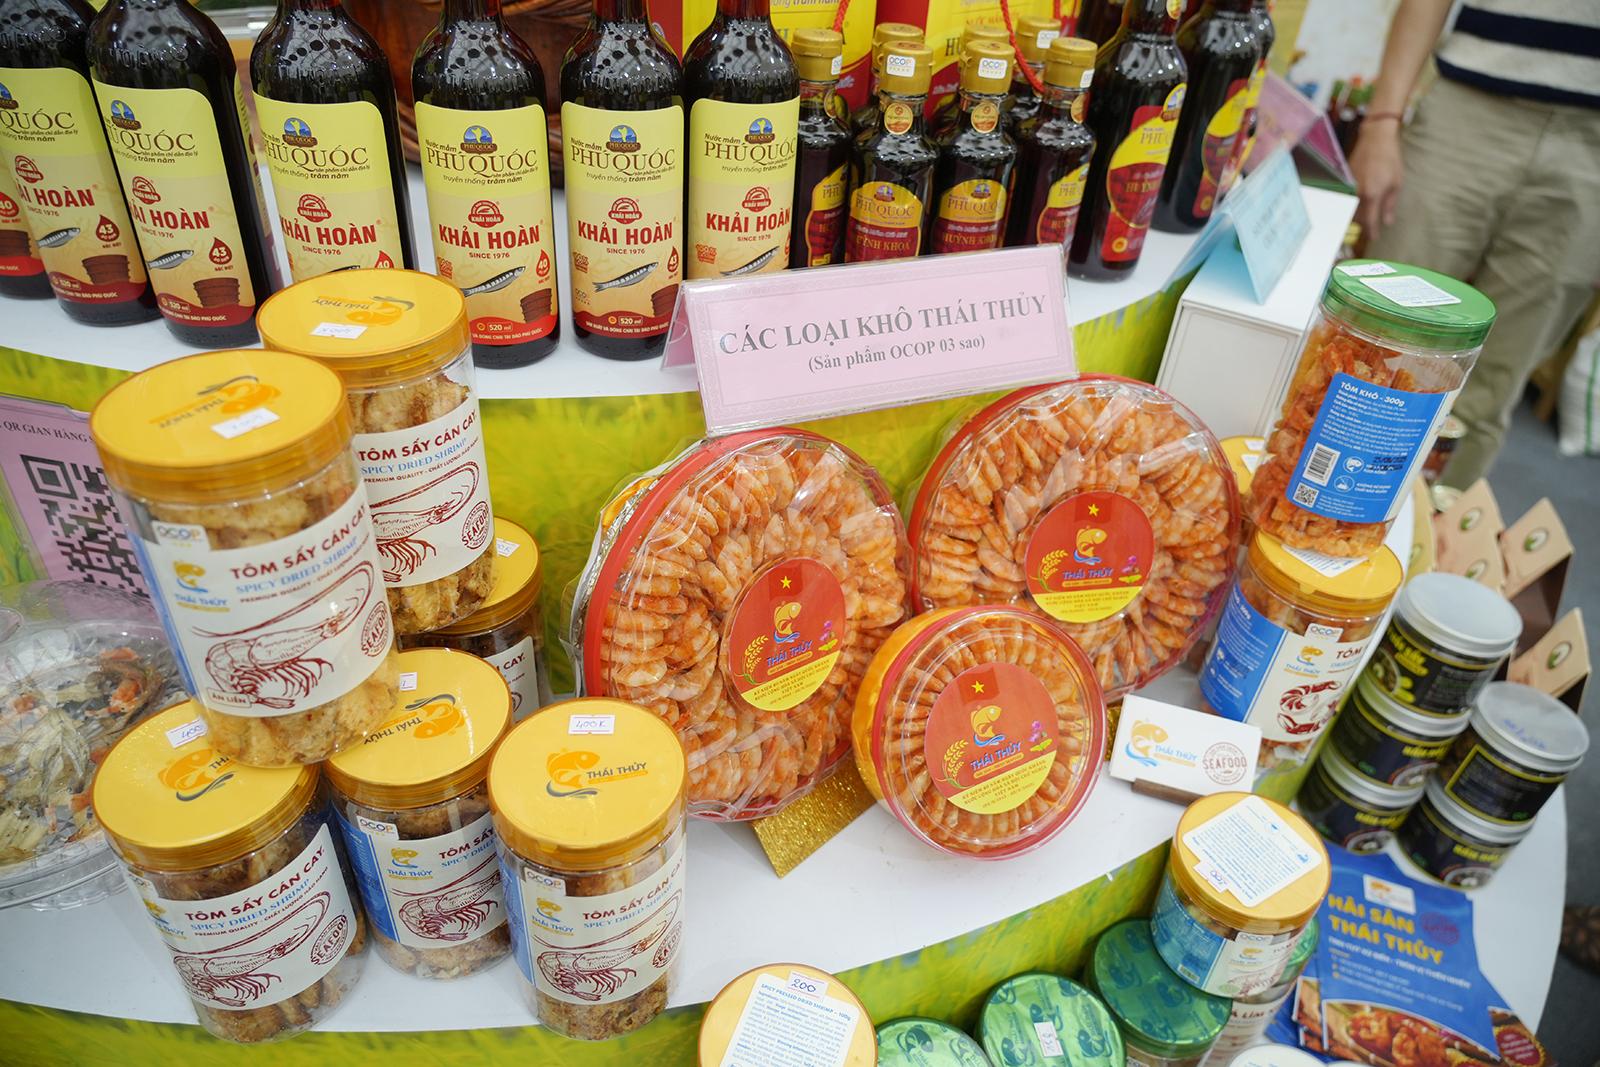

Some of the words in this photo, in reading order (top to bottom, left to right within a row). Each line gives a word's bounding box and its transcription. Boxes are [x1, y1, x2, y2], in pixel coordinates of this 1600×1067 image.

[704, 132, 722, 143] Nước
[722, 136, 742, 144] mắm
[426, 147, 466, 172] PHÚ
[571, 145, 611, 170] PHÚ
[704, 140, 747, 162] PHÚ
[487, 176, 506, 185] trăm
[33, 185, 96, 208] HOÀN
[99, 223, 114, 235] 43
[149, 207, 211, 230] HOÀN
[706, 211, 749, 234] KHẢI
[756, 208, 791, 233] HOÀN
[316, 222, 377, 247] HOÀN
[438, 223, 480, 250] KHẢI
[487, 225, 540, 250] HOÀN
[577, 220, 618, 245] KHẢI
[625, 221, 673, 246] HOÀN
[212, 246, 228, 258] 43
[302, 245, 323, 255] SINCE
[719, 323, 777, 355] CÁC
[785, 318, 849, 348] LOẠI
[855, 306, 913, 338] KHÔ
[918, 298, 978, 329] THÁI
[983, 291, 1047, 321] THỦY
[807, 347, 842, 374] (Sản
[845, 346, 887, 371] phẩm
[889, 341, 936, 360] OCOP
[939, 337, 957, 354] 03
[958, 335, 987, 352] sao)
[1340, 381, 1359, 394] TÔM
[1359, 388, 1379, 400] KHÔ
[1383, 396, 1406, 407] 300g
[3, 420, 21, 432] QR
[22, 424, 52, 437] GIAN
[53, 427, 88, 443] HÀNG
[358, 447, 398, 462] TÔM
[401, 437, 431, 458] SẤY
[434, 424, 461, 447] CÁN
[461, 409, 478, 431] CAY
[360, 464, 395, 476] SPICY
[397, 455, 433, 472] DRIED
[434, 437, 467, 460] SHRIMP
[363, 475, 396, 484] PREMIUM
[396, 470, 424, 481] QUALITY
[230, 561, 279, 580] TÔM
[283, 544, 316, 570] SẤY
[321, 523, 351, 552] CÁN
[236, 580, 277, 595] SPICY
[280, 564, 321, 586] DRIED
[1063, 569, 1086, 580] THÁI
[766, 650, 788, 668] THÁI
[395, 716, 423, 732] THÁI
[970, 753, 995, 771] THÁI
[995, 741, 1022, 761] THỦY
[1202, 756, 1248, 771] SEAFOOD
[586, 768, 615, 780] THÁI
[617, 761, 648, 775] THỦY
[359, 818, 394, 833] OCOP
[438, 843, 471, 860] TÔM
[441, 854, 468, 869] SPICY
[185, 910, 227, 922] TÔM
[230, 896, 264, 916] SẤY
[268, 872, 302, 899] CÁN
[303, 845, 324, 874] CAY
[386, 867, 407, 877] THÁI
[526, 870, 562, 889] OCOP
[190, 921, 226, 932] SPICY
[228, 908, 268, 928] DRIED
[269, 878, 310, 911] SHRIMP
[582, 908, 615, 921] TÔM
[619, 896, 644, 914] SẤY
[1328, 893, 1366, 919] HẢI
[1370, 908, 1416, 936] SẢN
[228, 921, 260, 934] QUALITY
[583, 920, 612, 929] SPICY
[310, 914, 348, 965] SEAFOOD
[1328, 914, 1380, 945] THÁI
[1383, 932, 1445, 966] THỦY
[791, 978, 817, 993] 200
